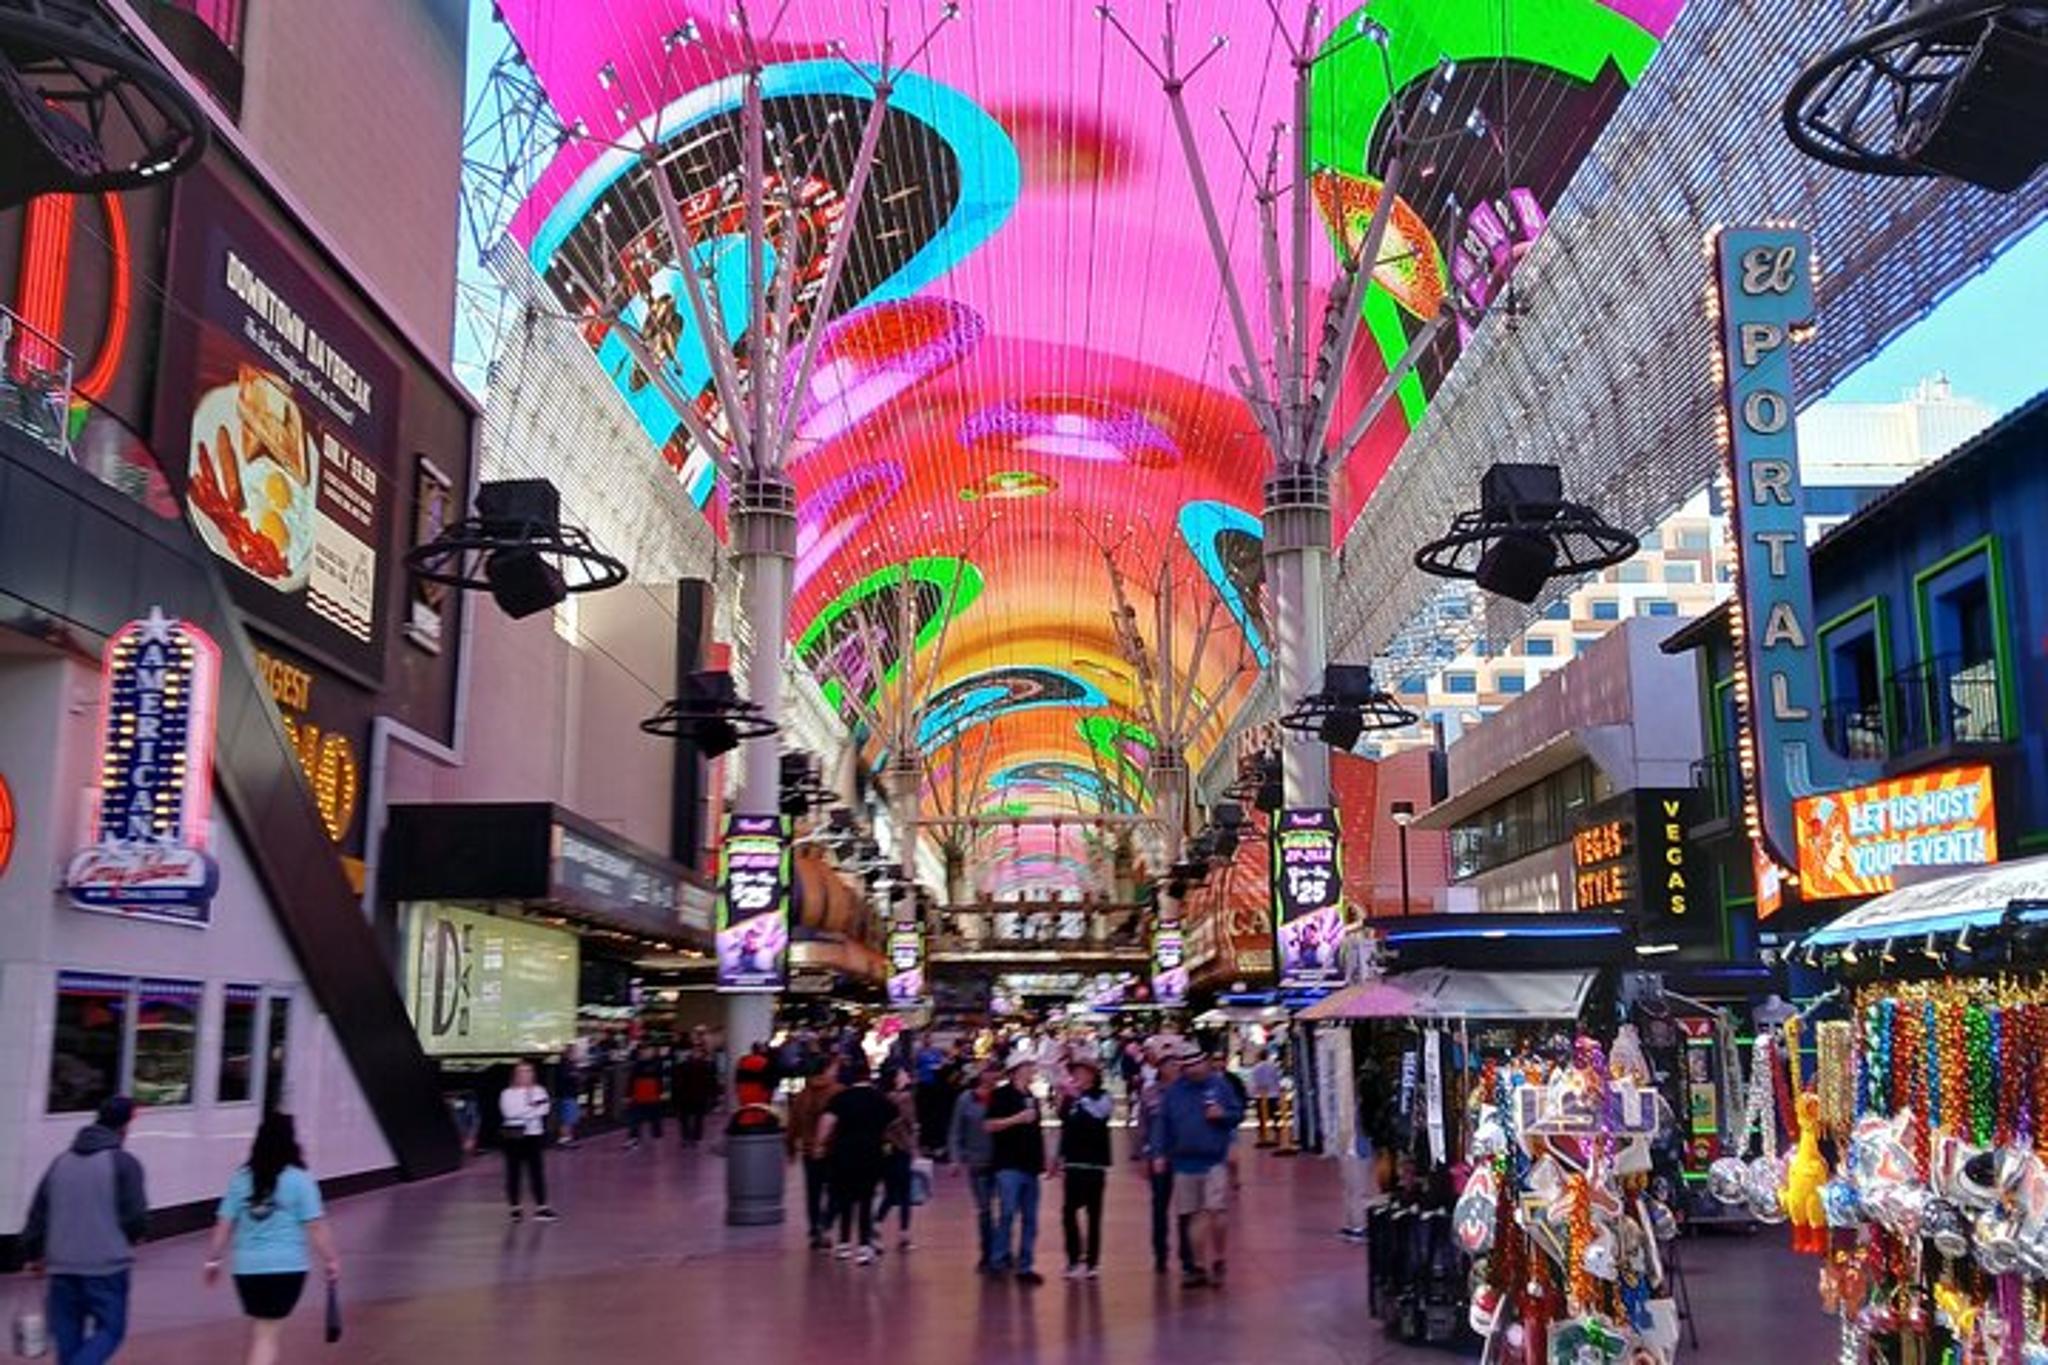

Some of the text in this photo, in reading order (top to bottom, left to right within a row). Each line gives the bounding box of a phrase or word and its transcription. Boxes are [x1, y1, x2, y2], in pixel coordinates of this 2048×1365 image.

[227, 251, 306, 353] DOWNTOWN
[306, 328, 372, 414] DAYBREAK
[1740, 246, 1810, 721] El PORTAL
[1663, 800, 1686, 914] VEGAS
[1849, 828, 1988, 877] YOUR EVENT!
[1850, 783, 1980, 837] LET US HOST
